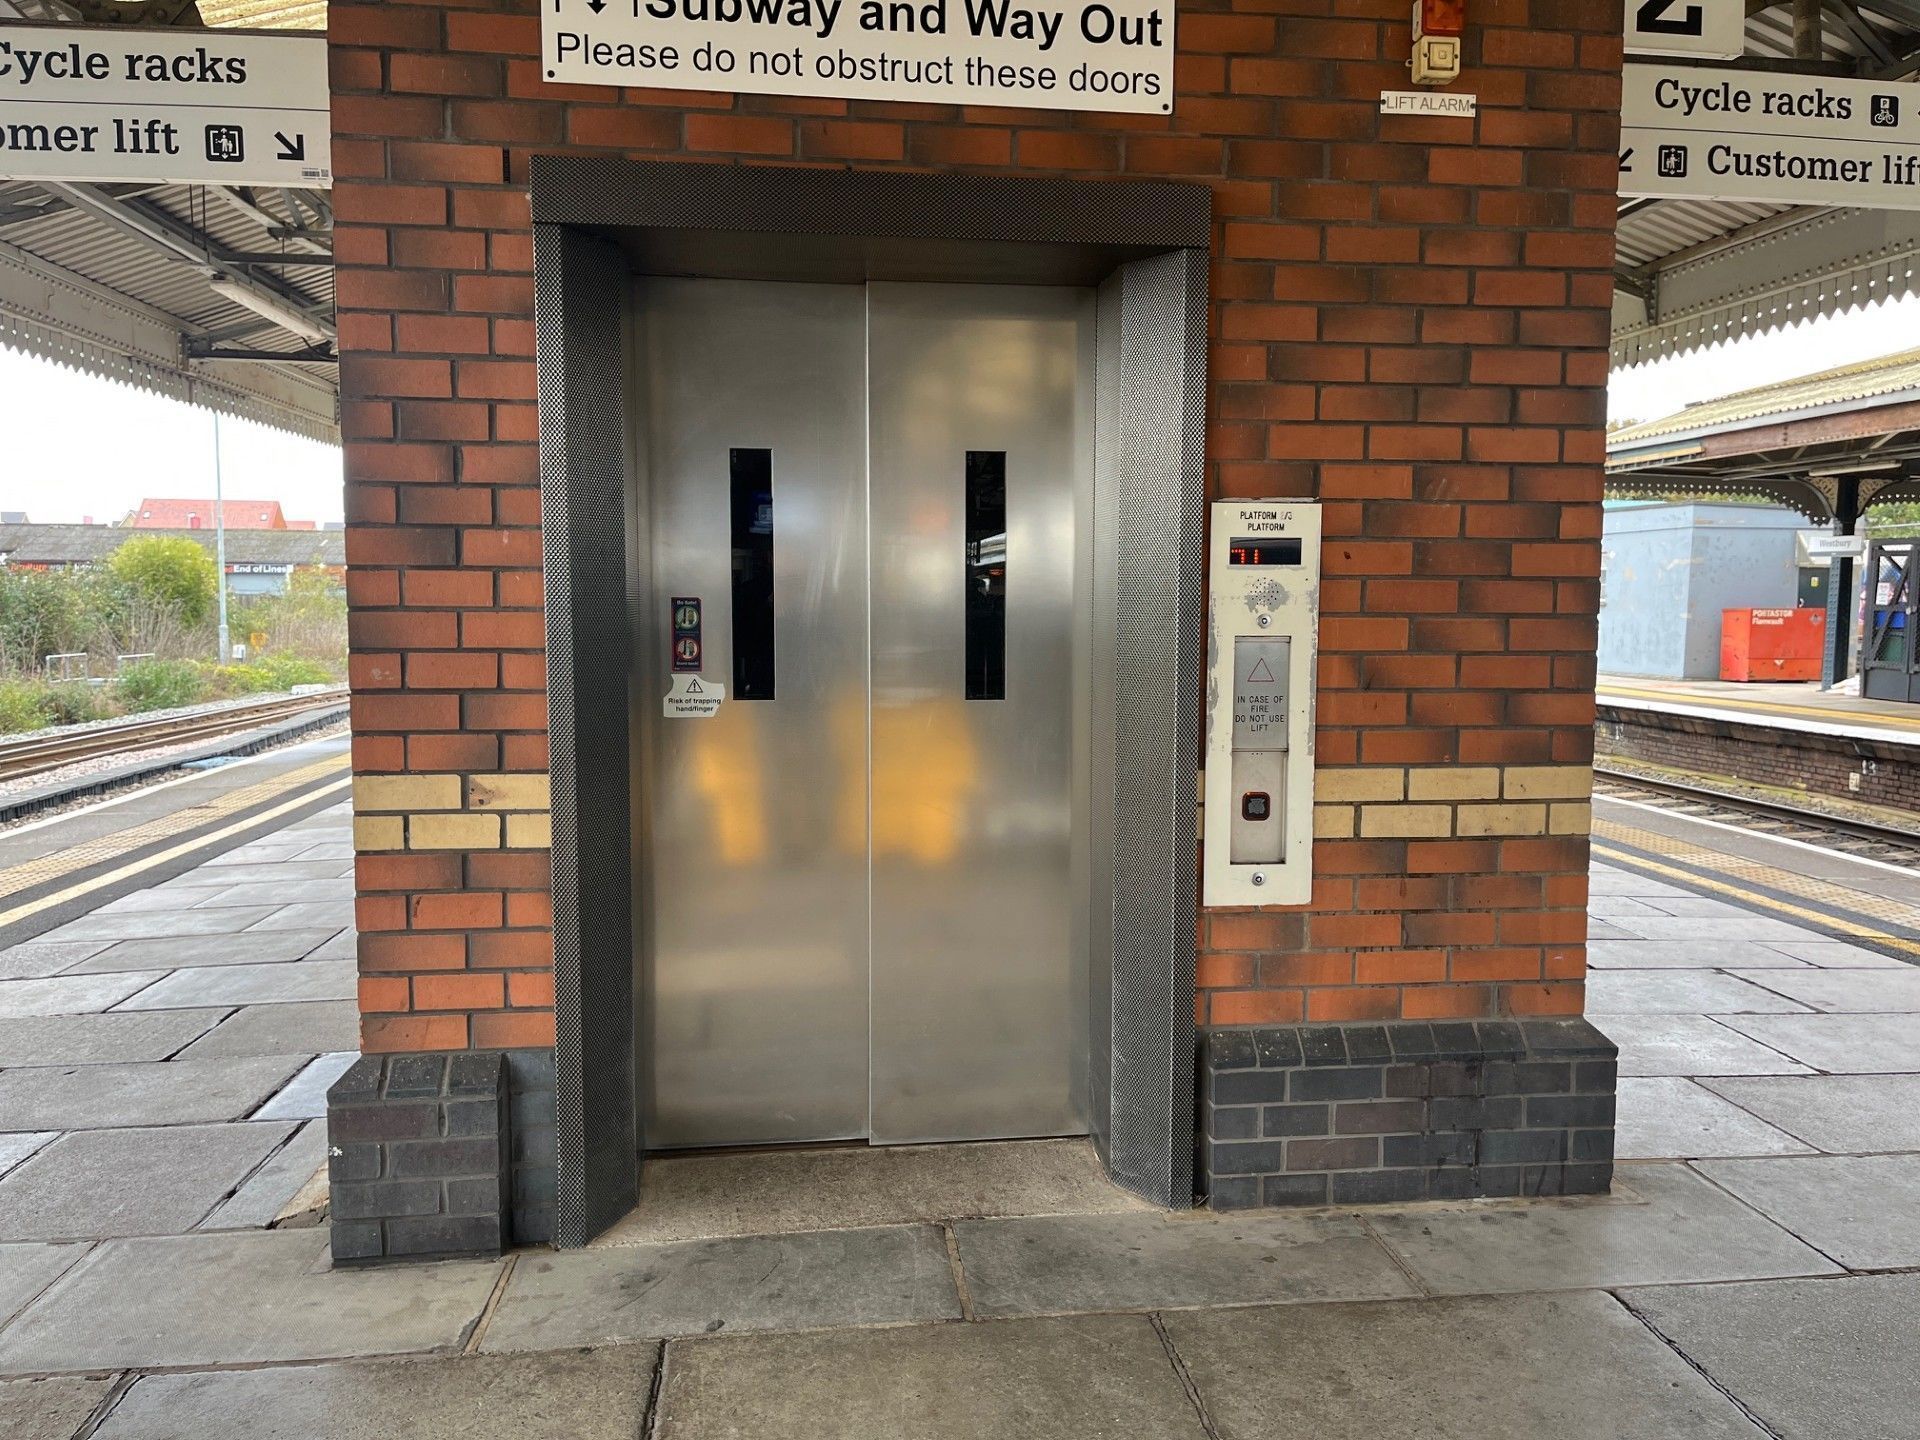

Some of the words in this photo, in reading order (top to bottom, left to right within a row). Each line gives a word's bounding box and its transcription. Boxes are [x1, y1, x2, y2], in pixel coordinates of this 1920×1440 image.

[859, 0, 946, 34] and
[965, 0, 1063, 50] Way
[1080, 4, 1162, 46] Out
[125, 48, 247, 84] racks
[557, 32, 679, 69] Please
[693, 41, 735, 72] do
[750, 47, 803, 76] not
[815, 49, 953, 85] obstruct
[966, 57, 1056, 89] these
[1069, 63, 1160, 95] doors
[1386, 96, 1417, 109] LIFT
[1420, 97, 1470, 112] ALARM
[1655, 79, 1751, 116] Cycle
[1762, 88, 1852, 119] racks
[0, 124, 98, 152] mer
[113, 119, 180, 154] lift
[1707, 145, 1872, 182] Customer
[1883, 155, 1920, 185] lif
[1240, 511, 1277, 520] PLATFORM
[1247, 523, 1284, 531] PLATFORM
[233, 565, 251, 573] End
[252, 565, 262, 573] of
[693, 698, 721, 706] trapping
[1249, 696, 1270, 704] CASE
[1273, 696, 1284, 704] OF
